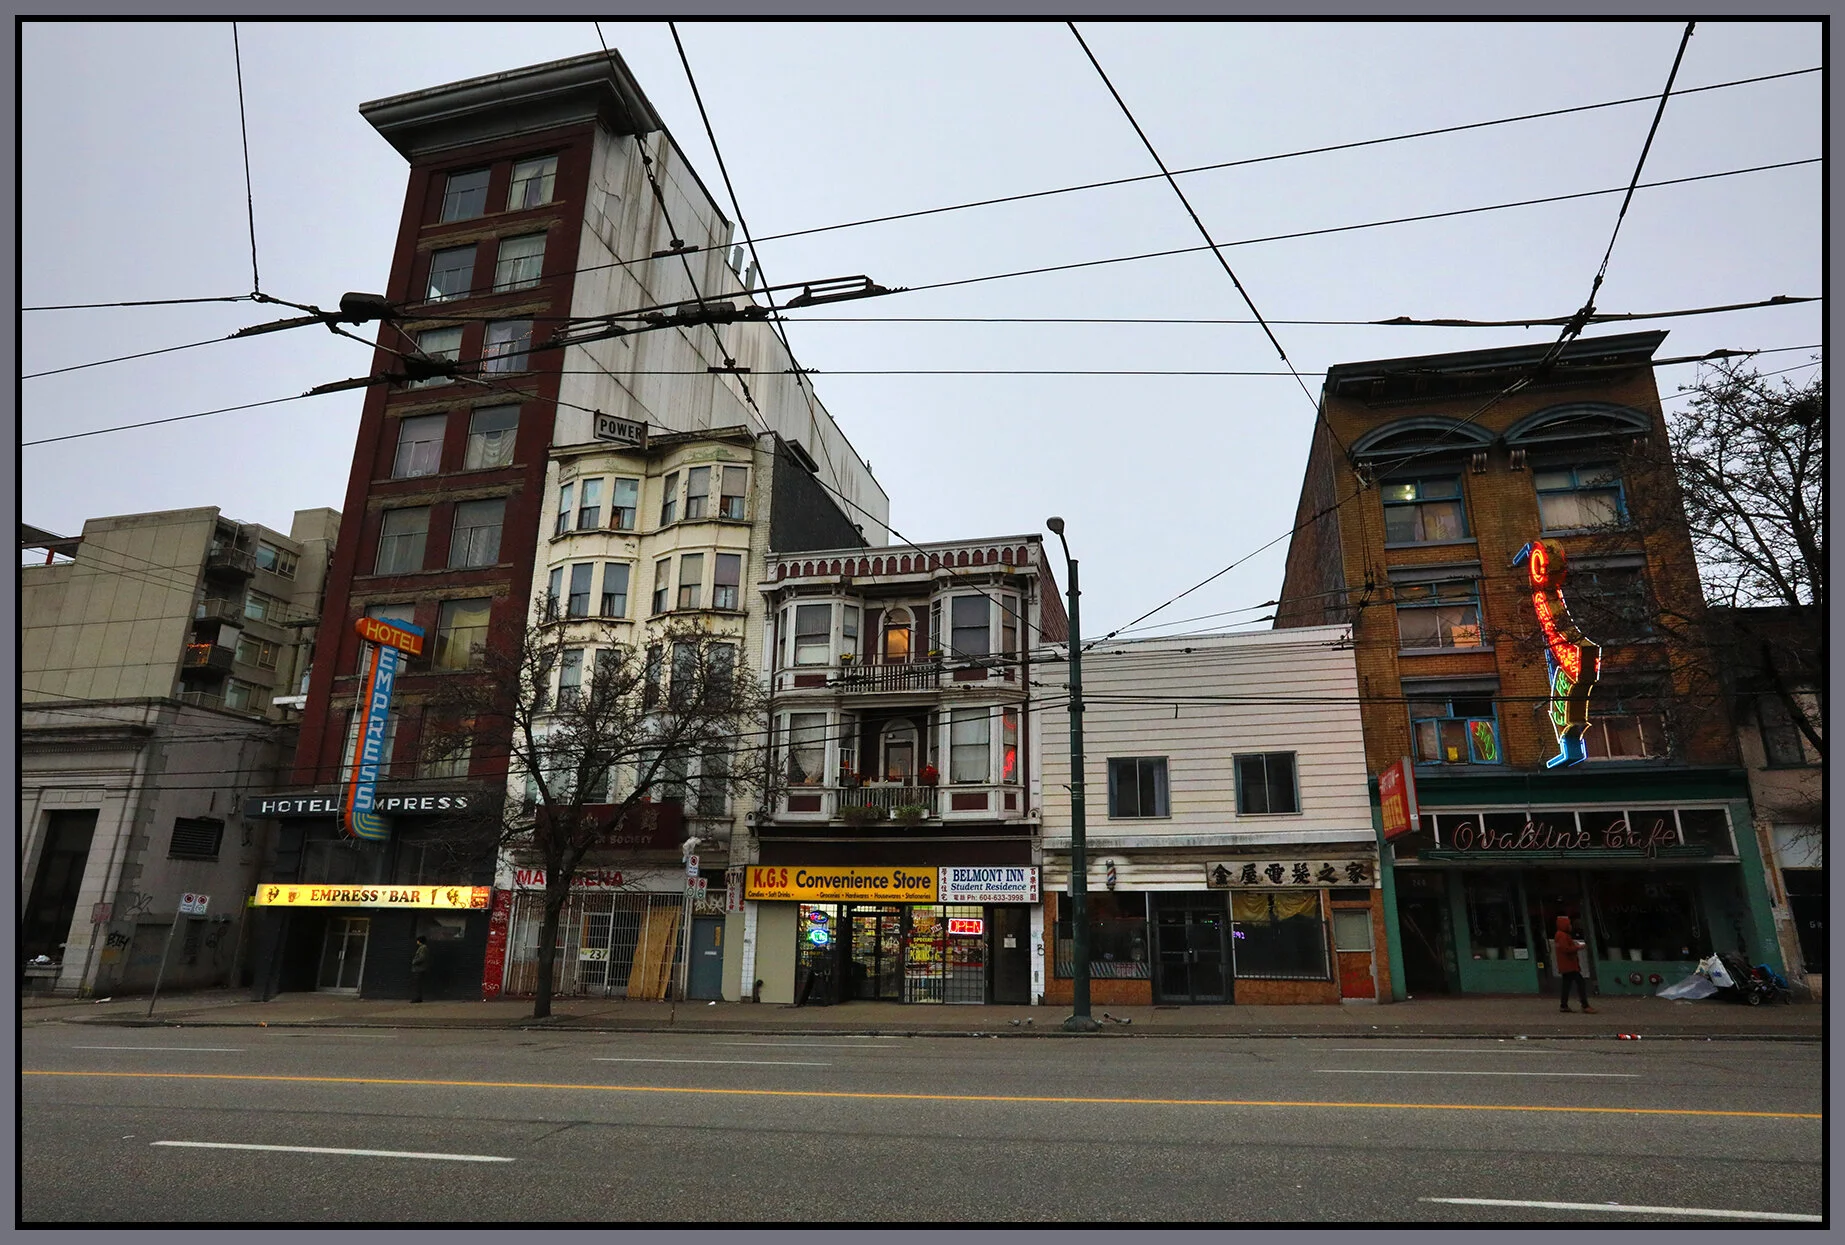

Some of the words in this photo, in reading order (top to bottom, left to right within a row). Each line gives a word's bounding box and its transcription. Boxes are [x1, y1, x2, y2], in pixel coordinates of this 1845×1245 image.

[600, 418, 641, 440] POWER
[366, 620, 421, 655] HOTEL
[356, 646, 397, 809] EMPRESS
[261, 800, 338, 813] HOTEL
[371, 796, 468, 811] MPRESS
[1453, 820, 1592, 851] Ovaltine
[1602, 818, 1677, 860] Cafe
[515, 869, 625, 887] MARENA
[753, 868, 788, 888] K.G.S
[796, 869, 888, 889] Convenience
[893, 870, 931, 889] Store
[953, 868, 1002, 882] BELMONT
[1006, 869, 1025, 882] INN
[1212, 862, 1368, 885] 金屋電髮之家
[311, 889, 379, 902] EMPRESS
[388, 889, 421, 903] BAR
[951, 883, 983, 891] Student
[985, 883, 1027, 891] Residence
[949, 920, 981, 933] OPEN
[589, 948, 608, 960] 237
